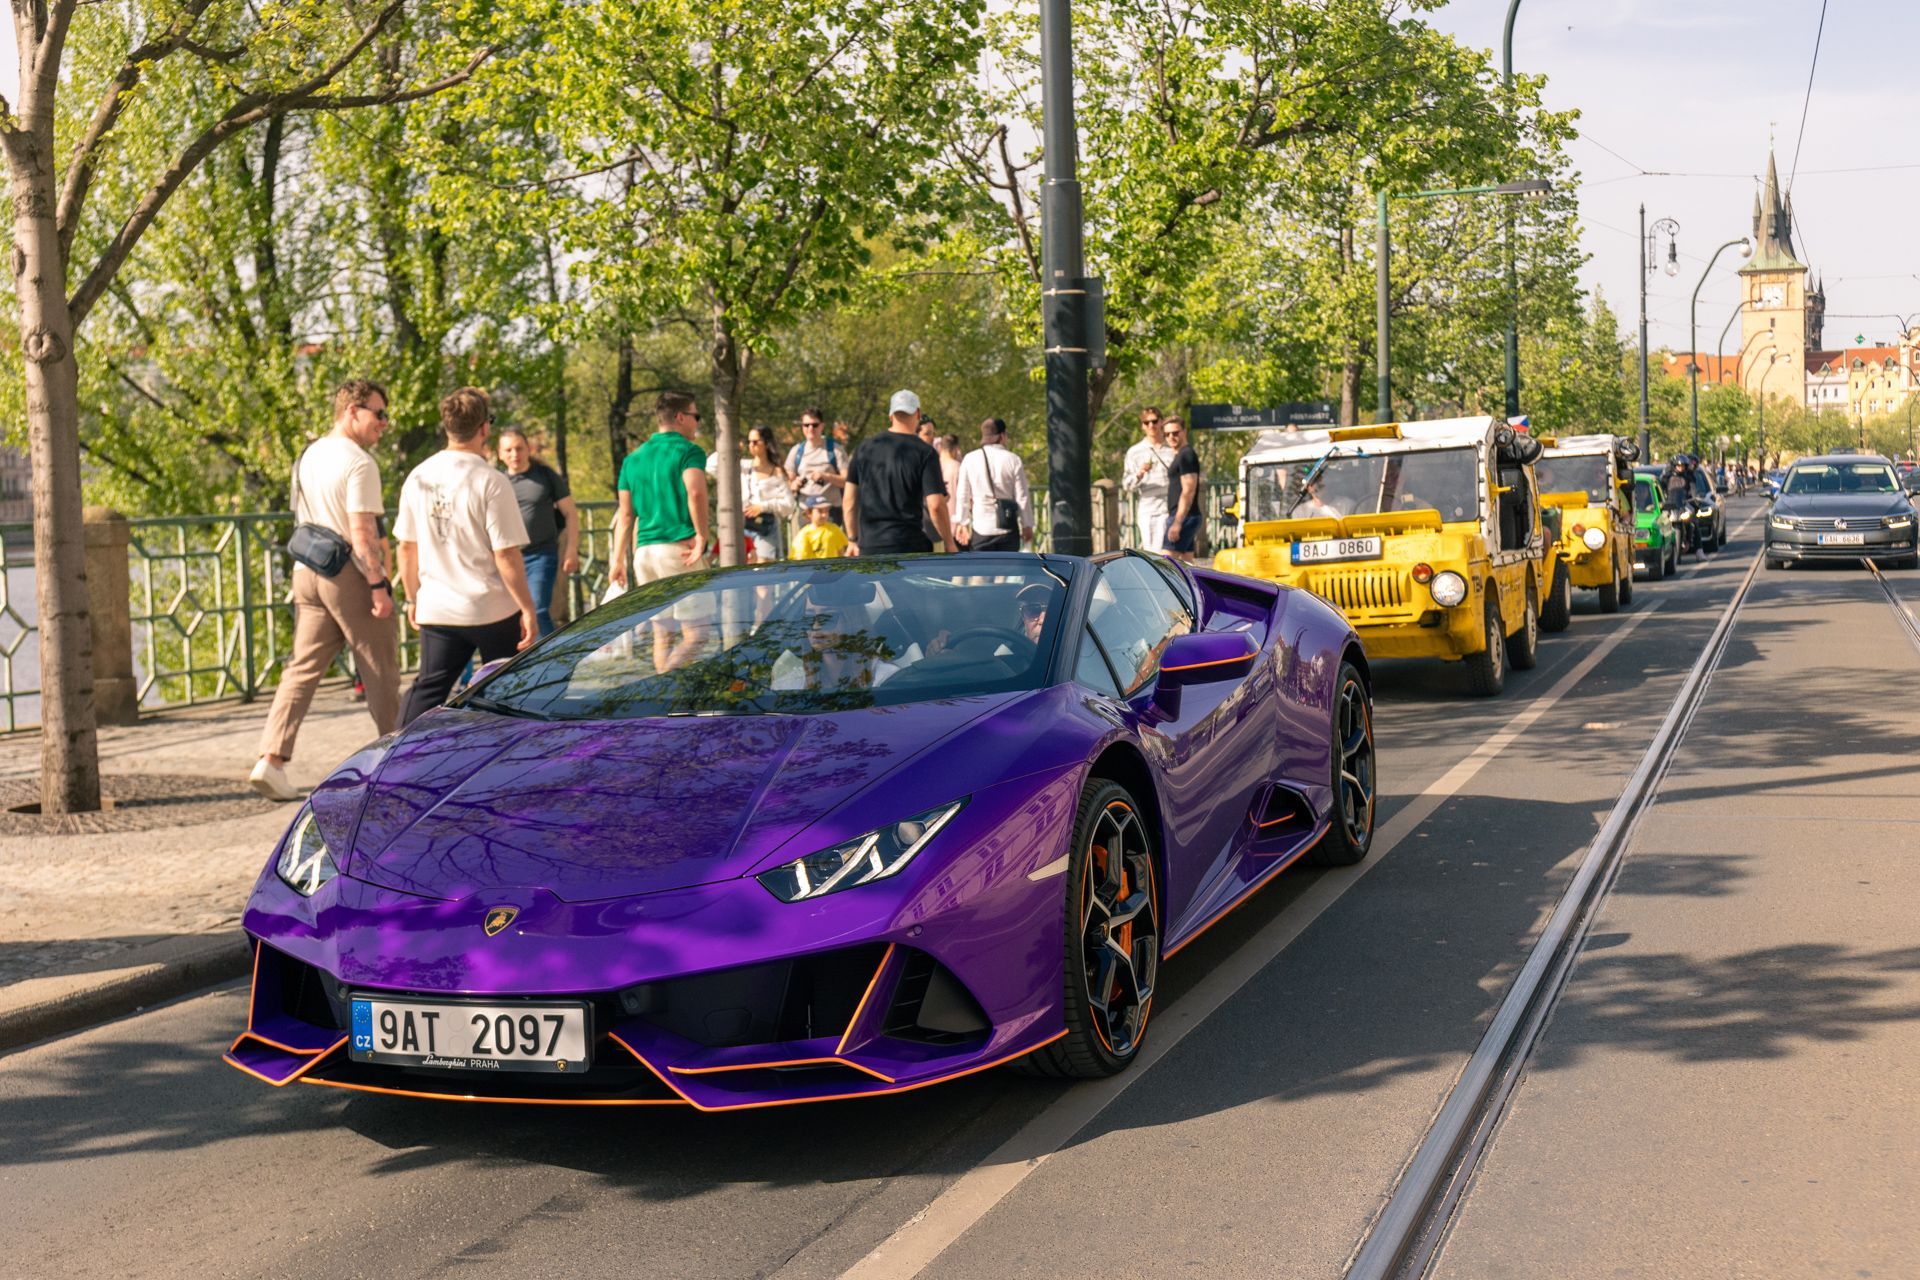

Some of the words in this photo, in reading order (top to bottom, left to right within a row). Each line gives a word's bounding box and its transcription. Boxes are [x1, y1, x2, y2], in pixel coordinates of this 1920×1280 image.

[1303, 543, 1328, 558] 8AJ
[1339, 540, 1373, 555] 0860
[379, 1009, 440, 1052] 9AT
[471, 1013, 565, 1056] 2097
[356, 1035, 371, 1047] CZ
[422, 1054, 467, 1069] Lamborghini
[470, 1059, 500, 1069] PRAHA
